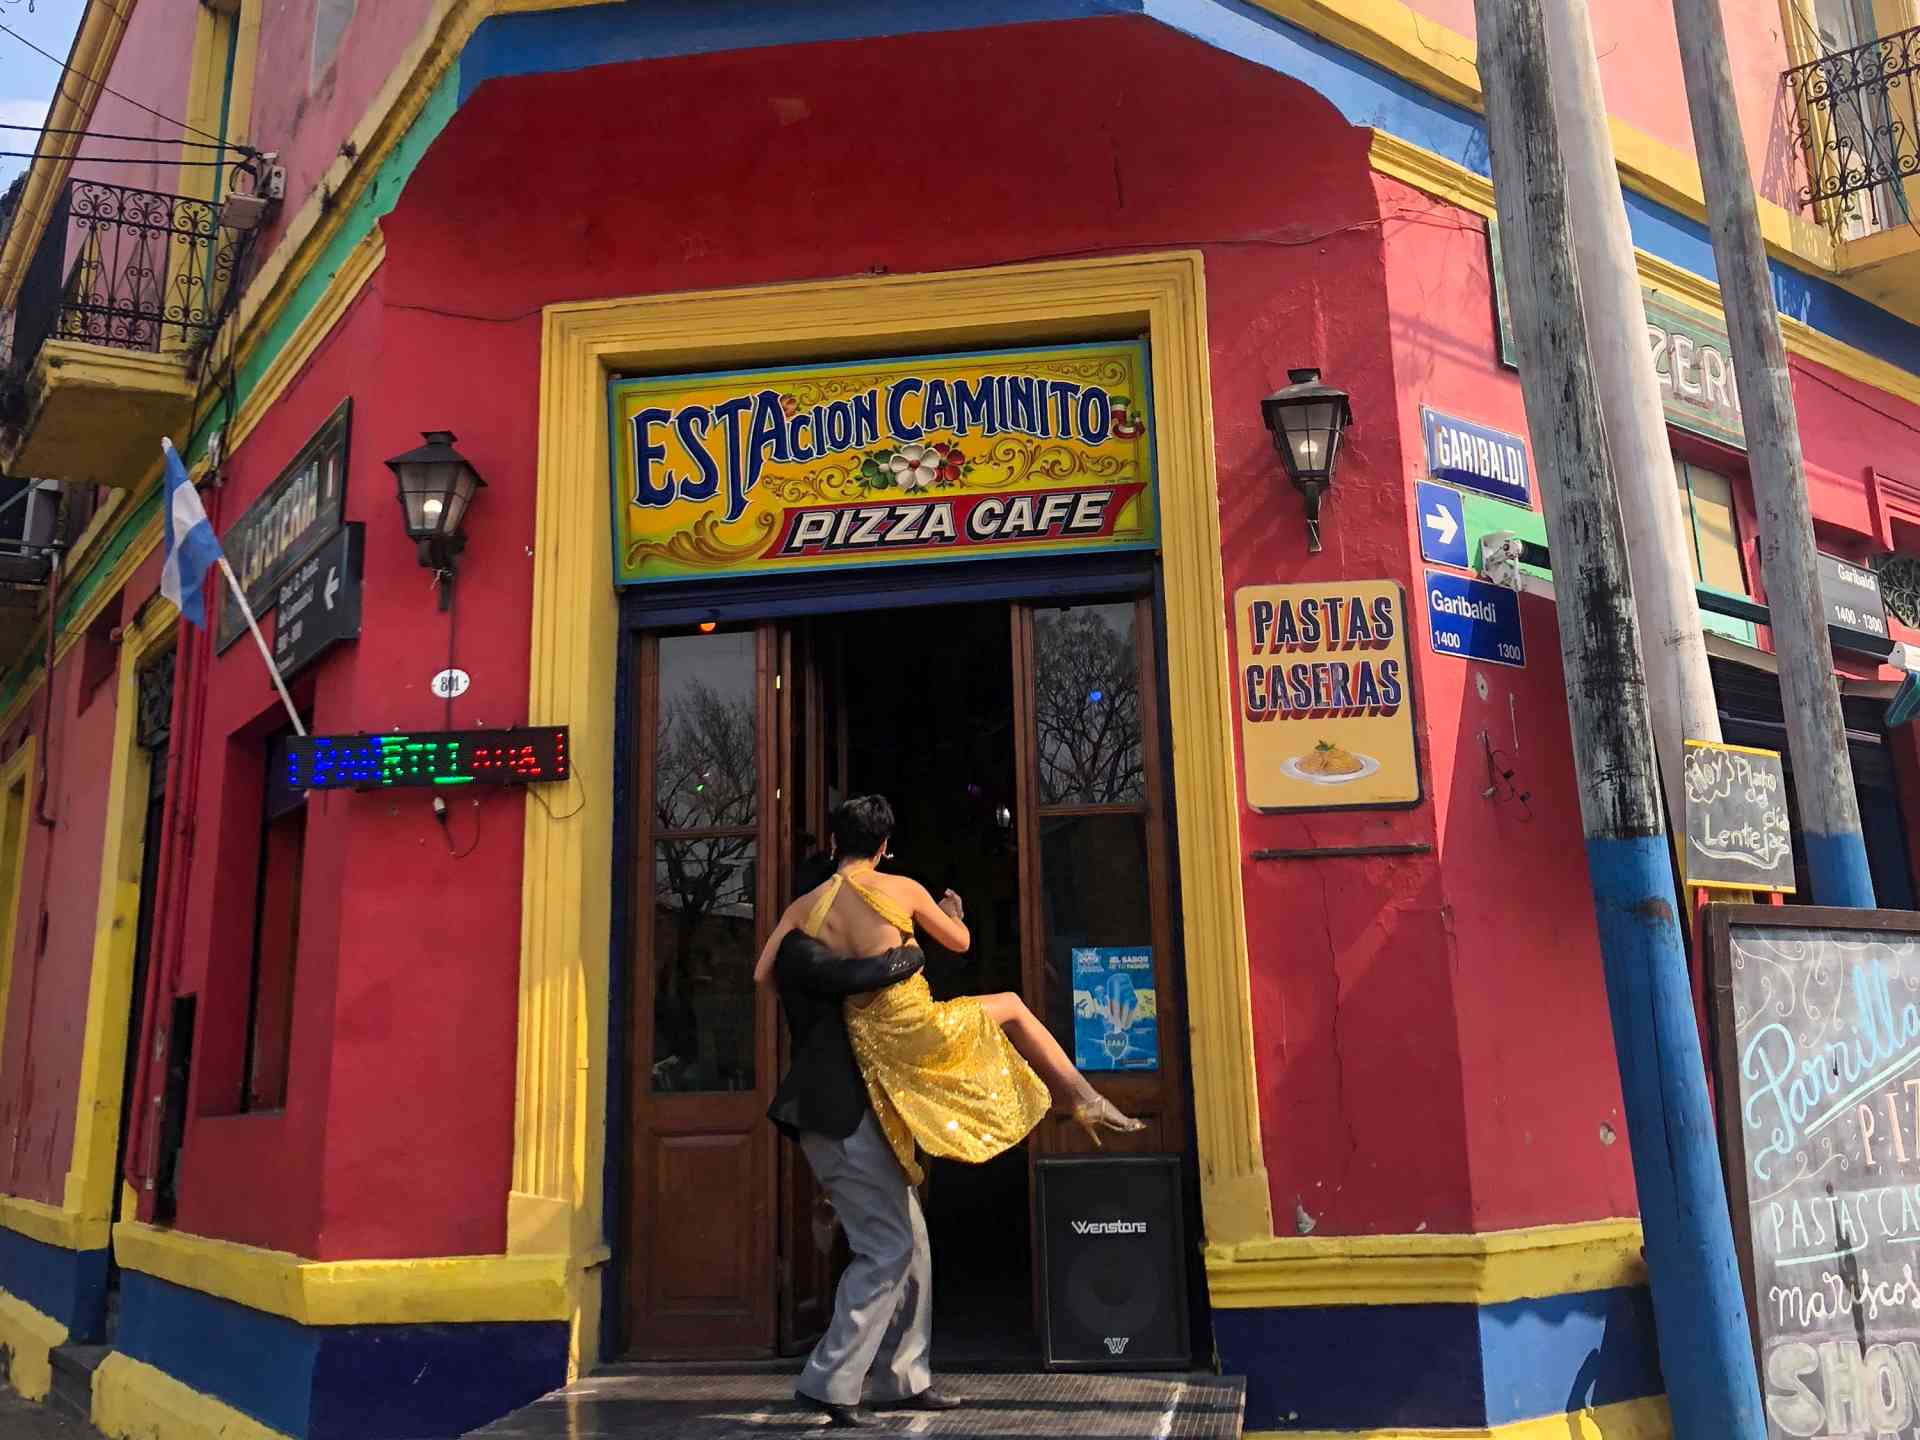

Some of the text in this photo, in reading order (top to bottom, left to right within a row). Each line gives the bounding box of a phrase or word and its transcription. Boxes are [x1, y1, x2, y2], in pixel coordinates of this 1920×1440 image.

[630, 375, 1112, 523] ESTACION CAMINITO
[1438, 426, 1526, 488] GARIBALDI
[787, 491, 1114, 554] PIZZA CAFE
[1430, 588, 1497, 624] Garibaldi
[1837, 562, 1876, 592] Garibaldi
[1249, 596, 1395, 655] PASTAS
[1834, 605, 1856, 625] 1400
[1434, 630, 1521, 661] 1400 1300
[1245, 659, 1402, 722] CASERAS
[1733, 756, 1777, 792] Plato
[1770, 1192, 1868, 1255] PASTAS
